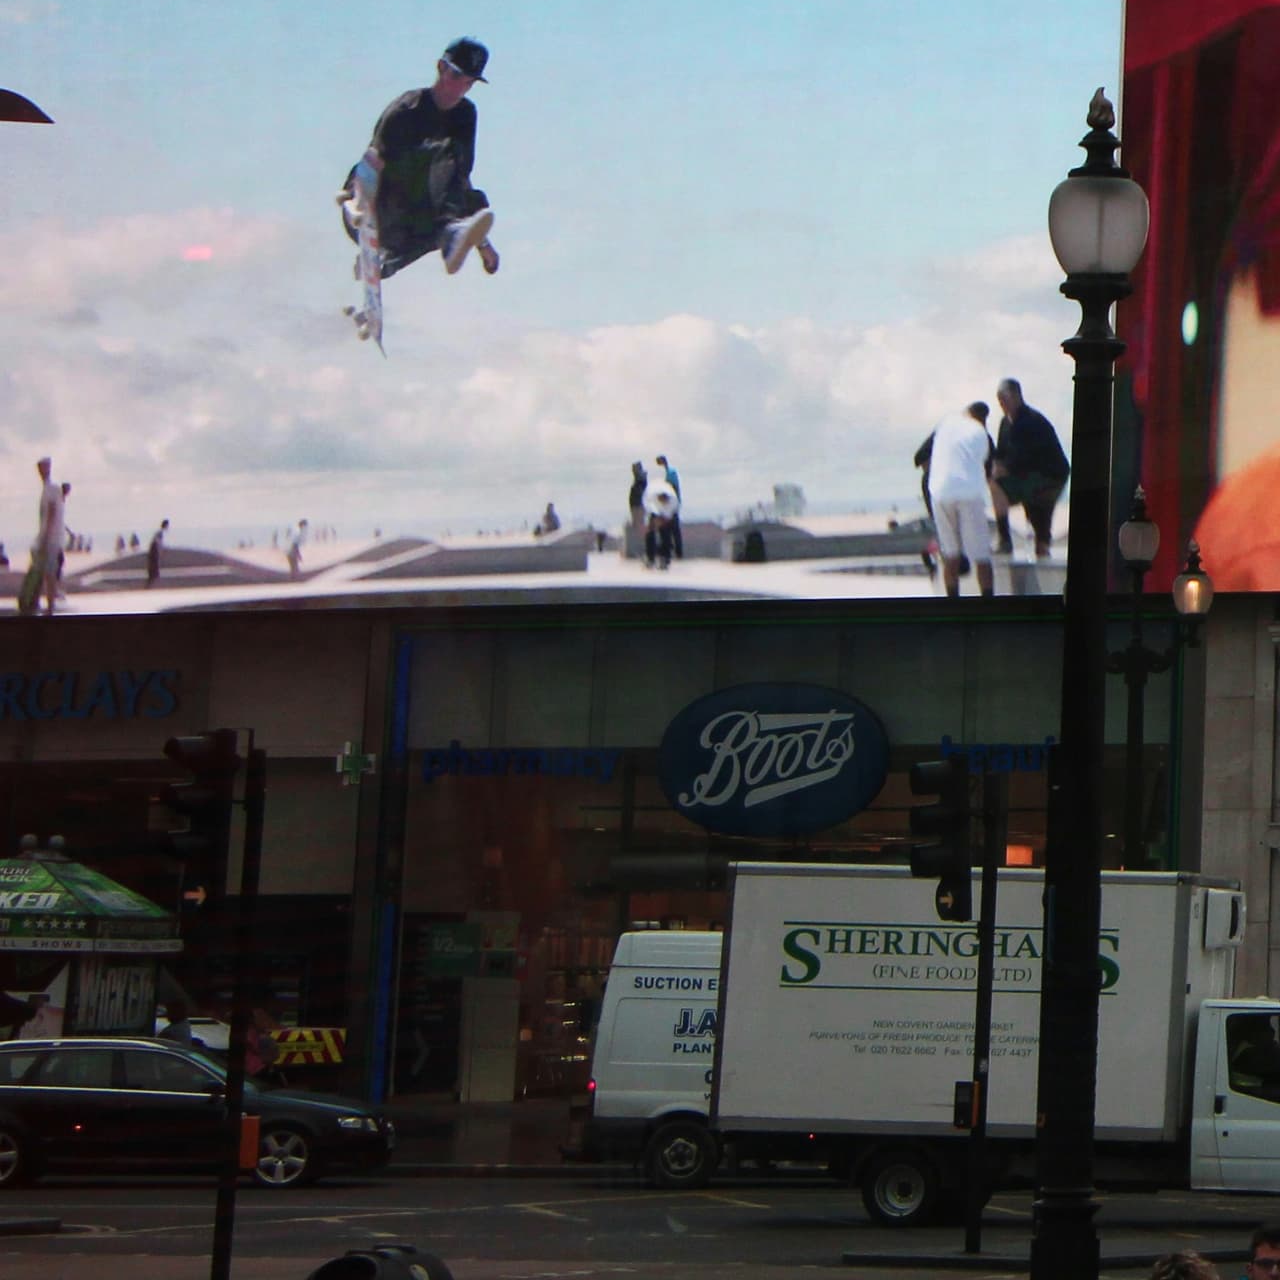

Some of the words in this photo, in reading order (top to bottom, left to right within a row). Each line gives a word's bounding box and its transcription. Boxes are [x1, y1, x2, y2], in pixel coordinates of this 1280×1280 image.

[422, 739, 622, 784] pharmacy
[677, 708, 856, 808] Boots
[780, 926, 1121, 991] SHERINGHAS
[634, 976, 703, 990] SUCTION
[998, 1036, 1041, 1045] CATERIN
